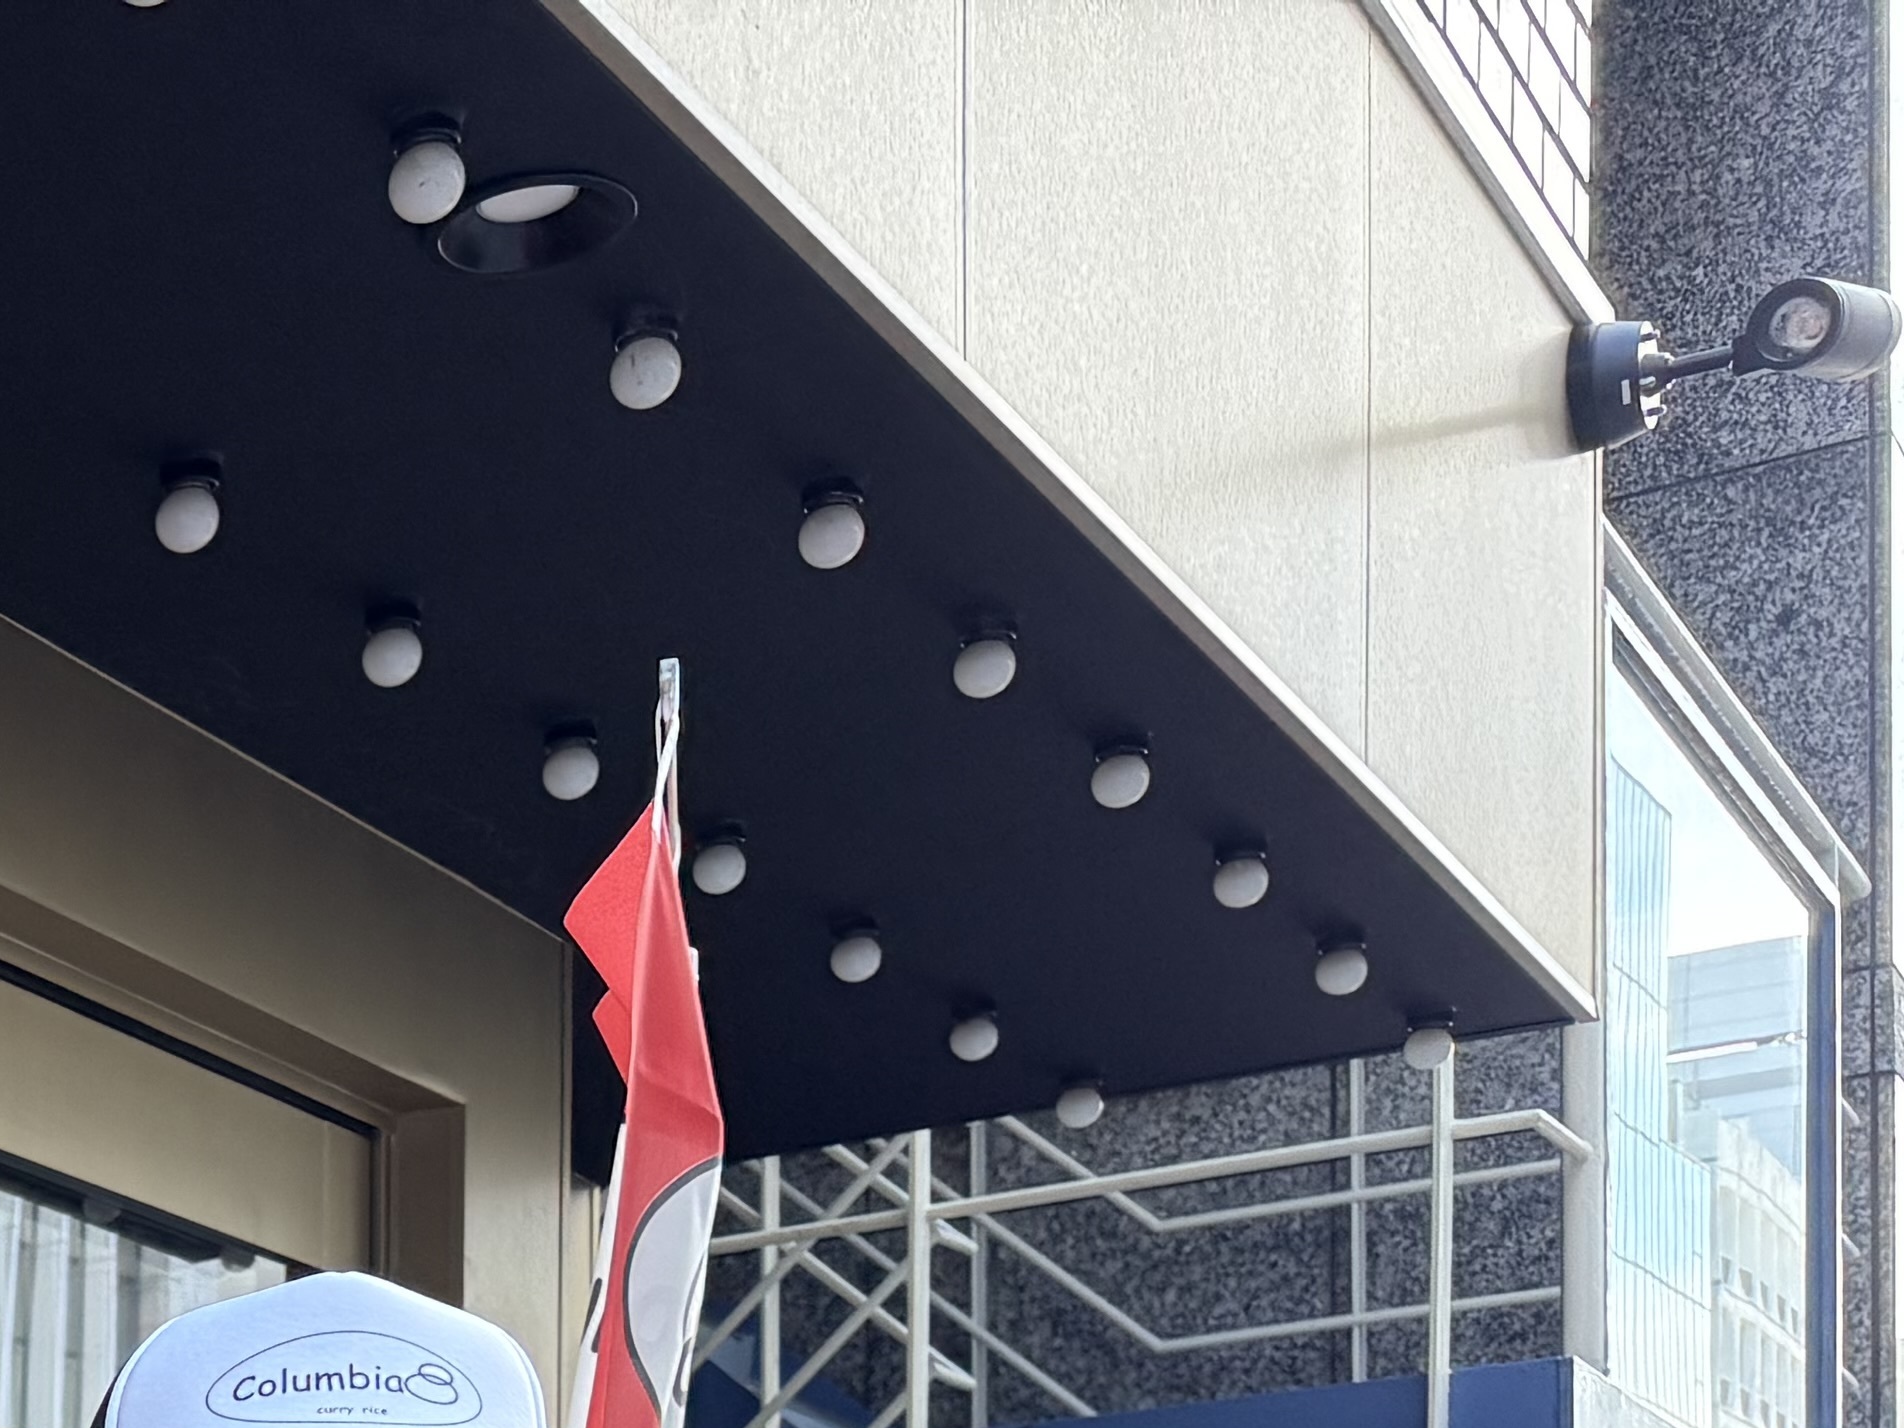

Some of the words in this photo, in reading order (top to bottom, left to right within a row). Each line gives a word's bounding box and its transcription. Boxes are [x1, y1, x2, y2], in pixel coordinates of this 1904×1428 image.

[232, 1362, 405, 1402] Columbia
[316, 1406, 354, 1417] curry
[362, 1405, 388, 1416] rice
